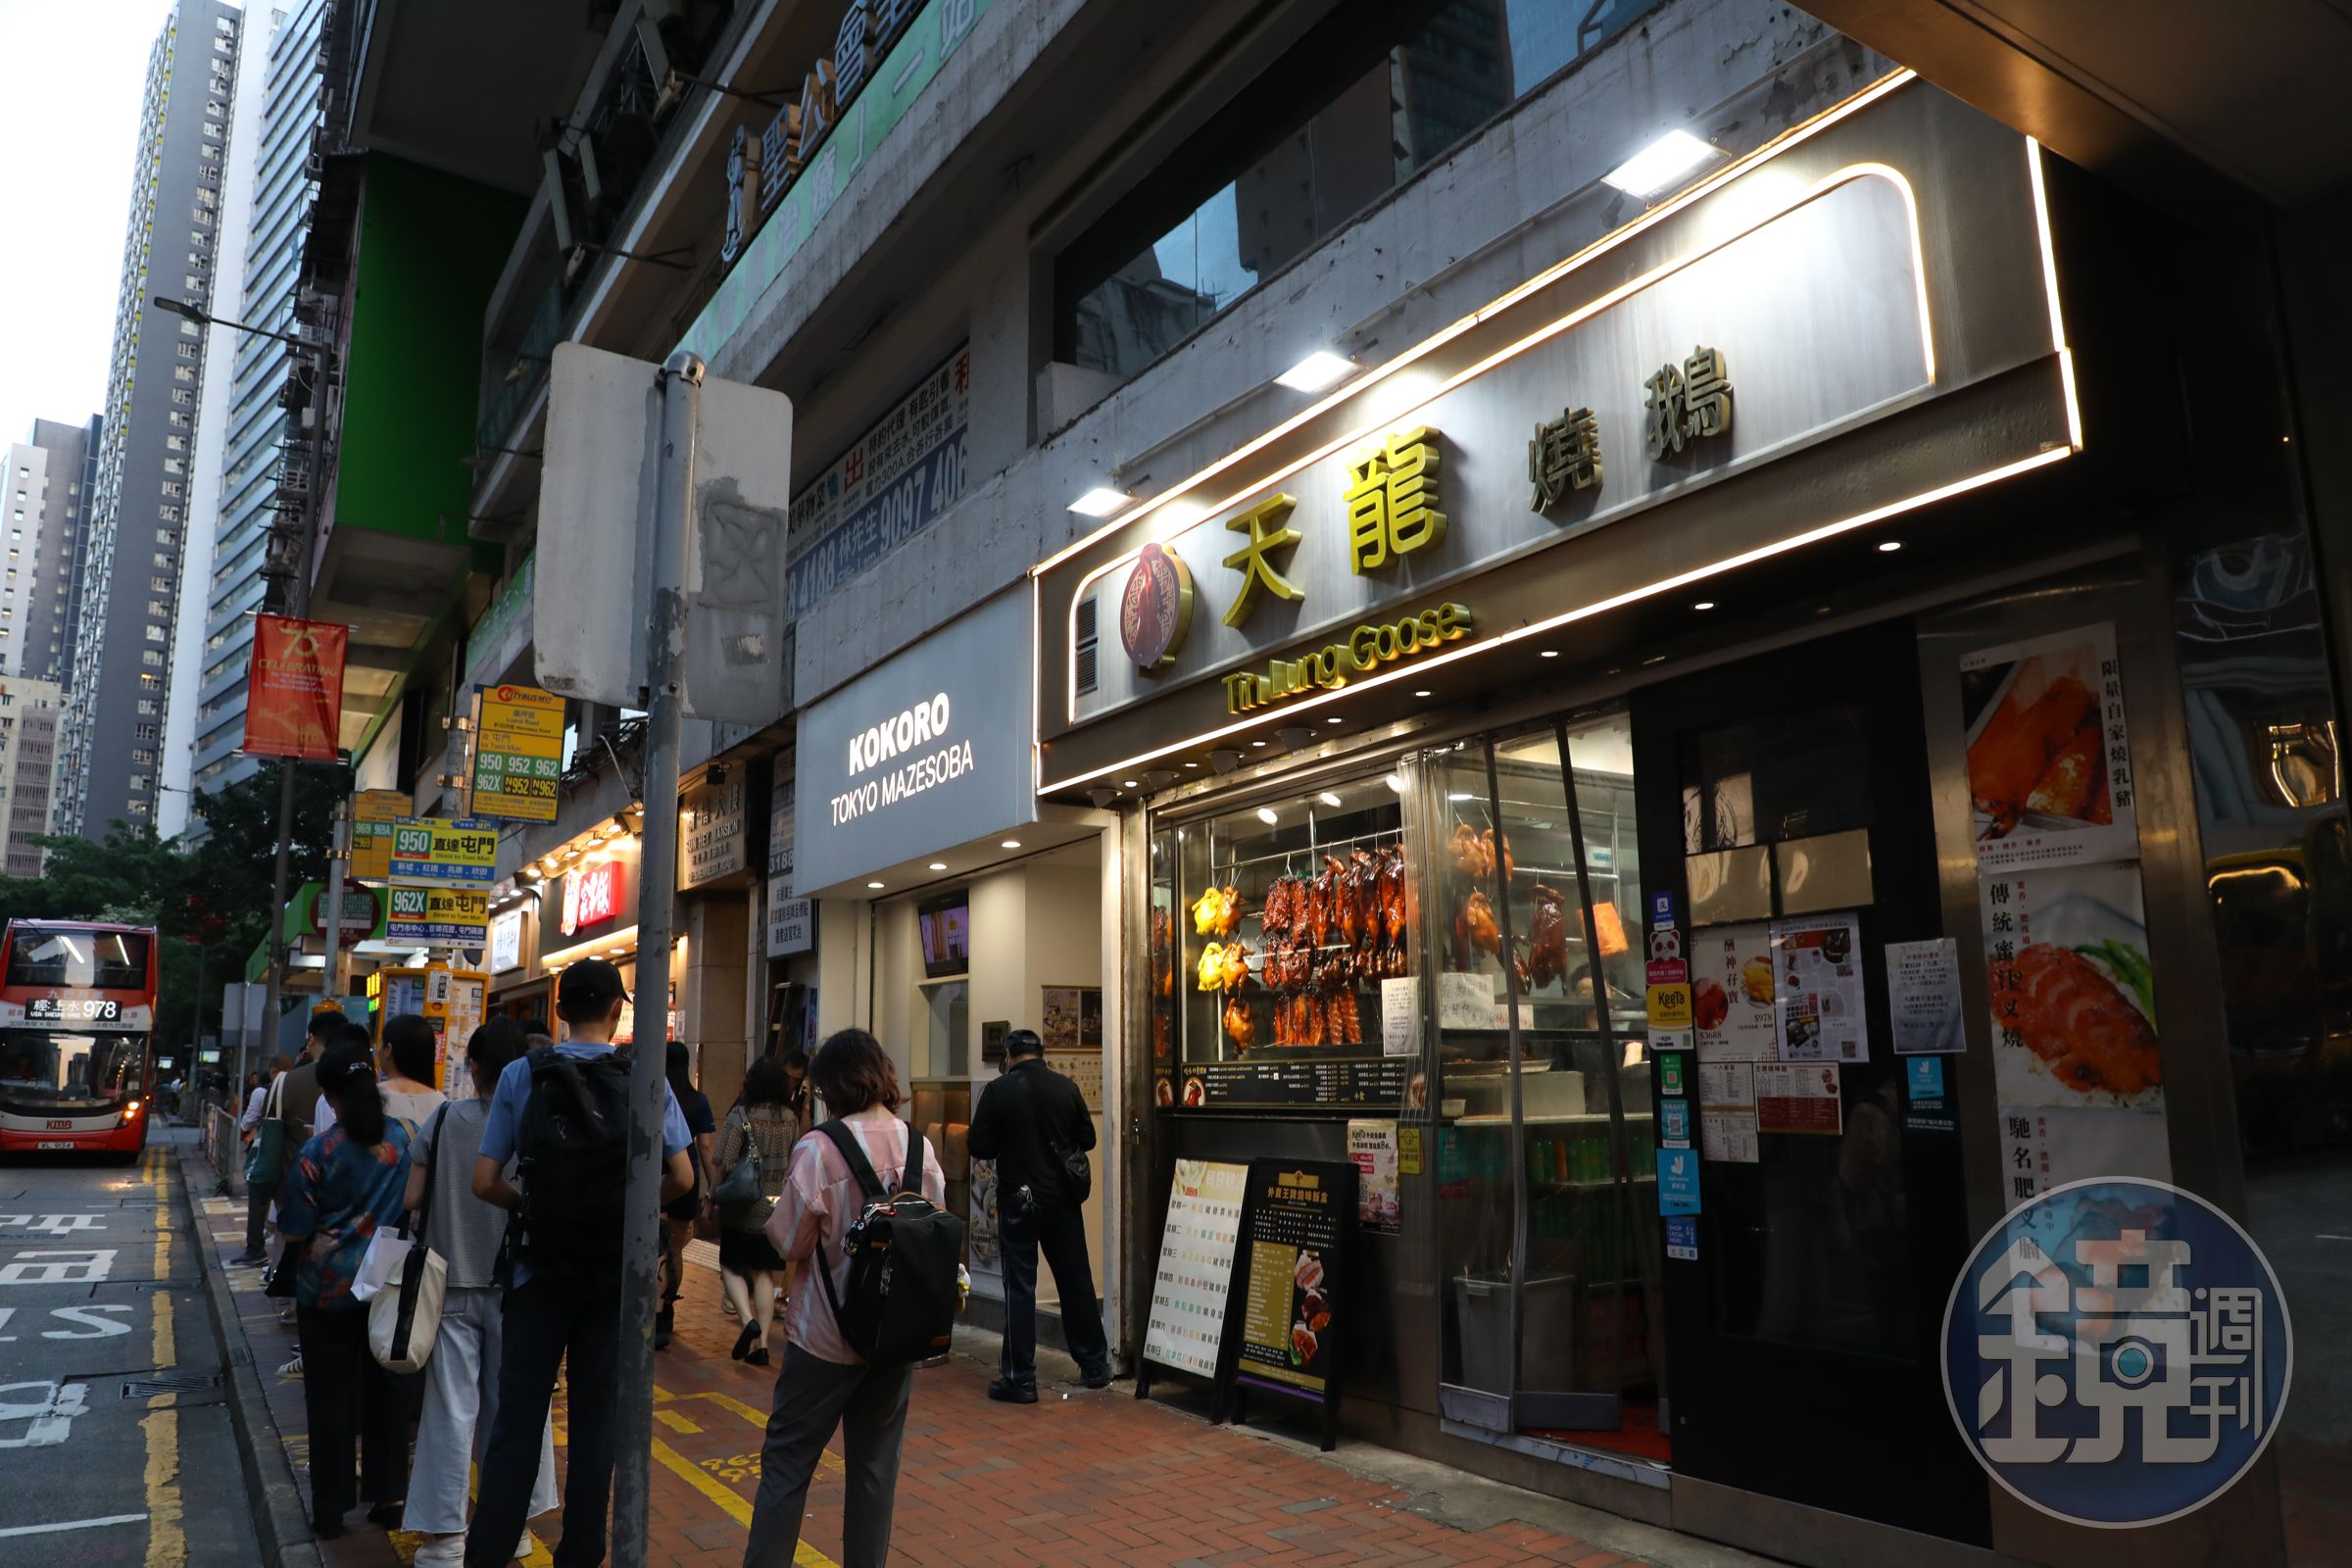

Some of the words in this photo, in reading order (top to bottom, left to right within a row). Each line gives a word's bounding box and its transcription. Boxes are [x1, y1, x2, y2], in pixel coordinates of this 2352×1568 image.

[844, 448, 864, 493] 出
[1222, 425, 1448, 627] 天龍
[1529, 345, 1734, 514] 燒鵝
[880, 465, 927, 552] 9097
[839, 507, 878, 565] 林先生
[799, 539, 835, 610] 4188
[279, 626, 325, 660] 75
[258, 659, 338, 676] CELEBRATING
[1222, 670, 1276, 713] Tin
[1269, 643, 1349, 698] Lung
[1349, 602, 1472, 671] Goose
[505, 689, 536, 703] CITYBUS
[850, 693, 950, 776] KOKORO
[2101, 659, 2132, 808] 限量自家燒乳豬
[480, 754, 502, 770] 950
[509, 757, 530, 773] 952
[535, 760, 558, 777] 962
[477, 774, 501, 791] 962X
[505, 776, 529, 796] N952
[532, 779, 557, 798] N962
[831, 781, 878, 826] TOKYO
[882, 740, 973, 807] MAZESOBA
[356, 823, 371, 835] 969
[711, 819, 738, 842] MANSION
[399, 831, 428, 852] 950
[432, 835, 495, 855] 直達屯門
[768, 849, 793, 873] 3188
[394, 891, 425, 912] 962X
[428, 894, 486, 913] 直達屯門
[1990, 883, 2024, 1049] 傳統蜜汁叉燒
[83, 1001, 117, 1019] 978
[1754, 1014, 1773, 1023] $978
[1699, 1031, 1722, 1041] $3688
[46, 1120, 73, 1129] KMB
[1170, 1200, 1188, 1209] 星期一
[1267, 1186, 1329, 1204] 外賣王牌燒味飯盒
[1167, 1224, 1183, 1235] 星期二
[1162, 1248, 1177, 1258] 星期三
[1158, 1271, 1174, 1283] 星期四
[1154, 1295, 1169, 1307] 星期五
[1151, 1319, 1165, 1331] 星期六
[1146, 1343, 1161, 1356] 星期日
